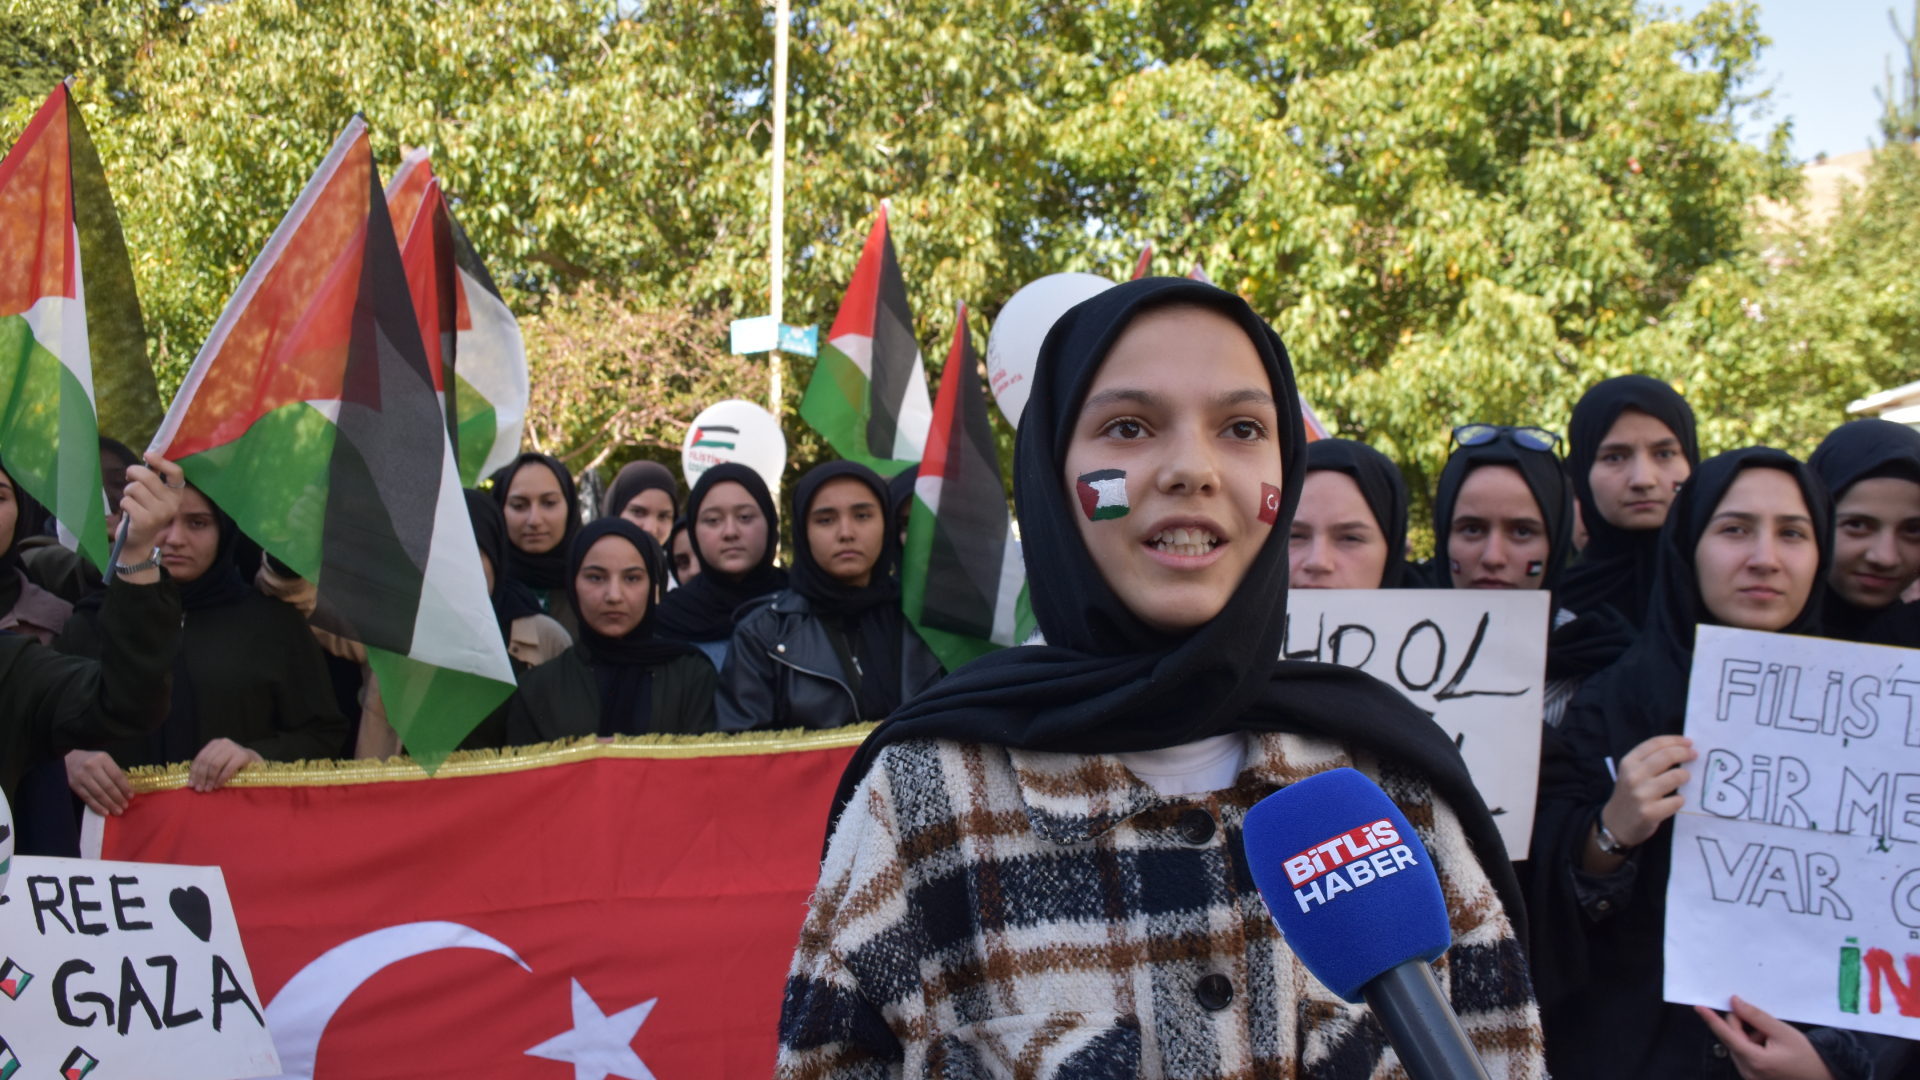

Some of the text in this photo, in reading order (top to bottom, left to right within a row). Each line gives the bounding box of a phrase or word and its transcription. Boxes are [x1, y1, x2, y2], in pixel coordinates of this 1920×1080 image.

[0, 874, 153, 936] REE
[1293, 844, 1419, 914] HABER
[1696, 836, 1853, 921] VAR
[52, 954, 265, 1036] GAZA
